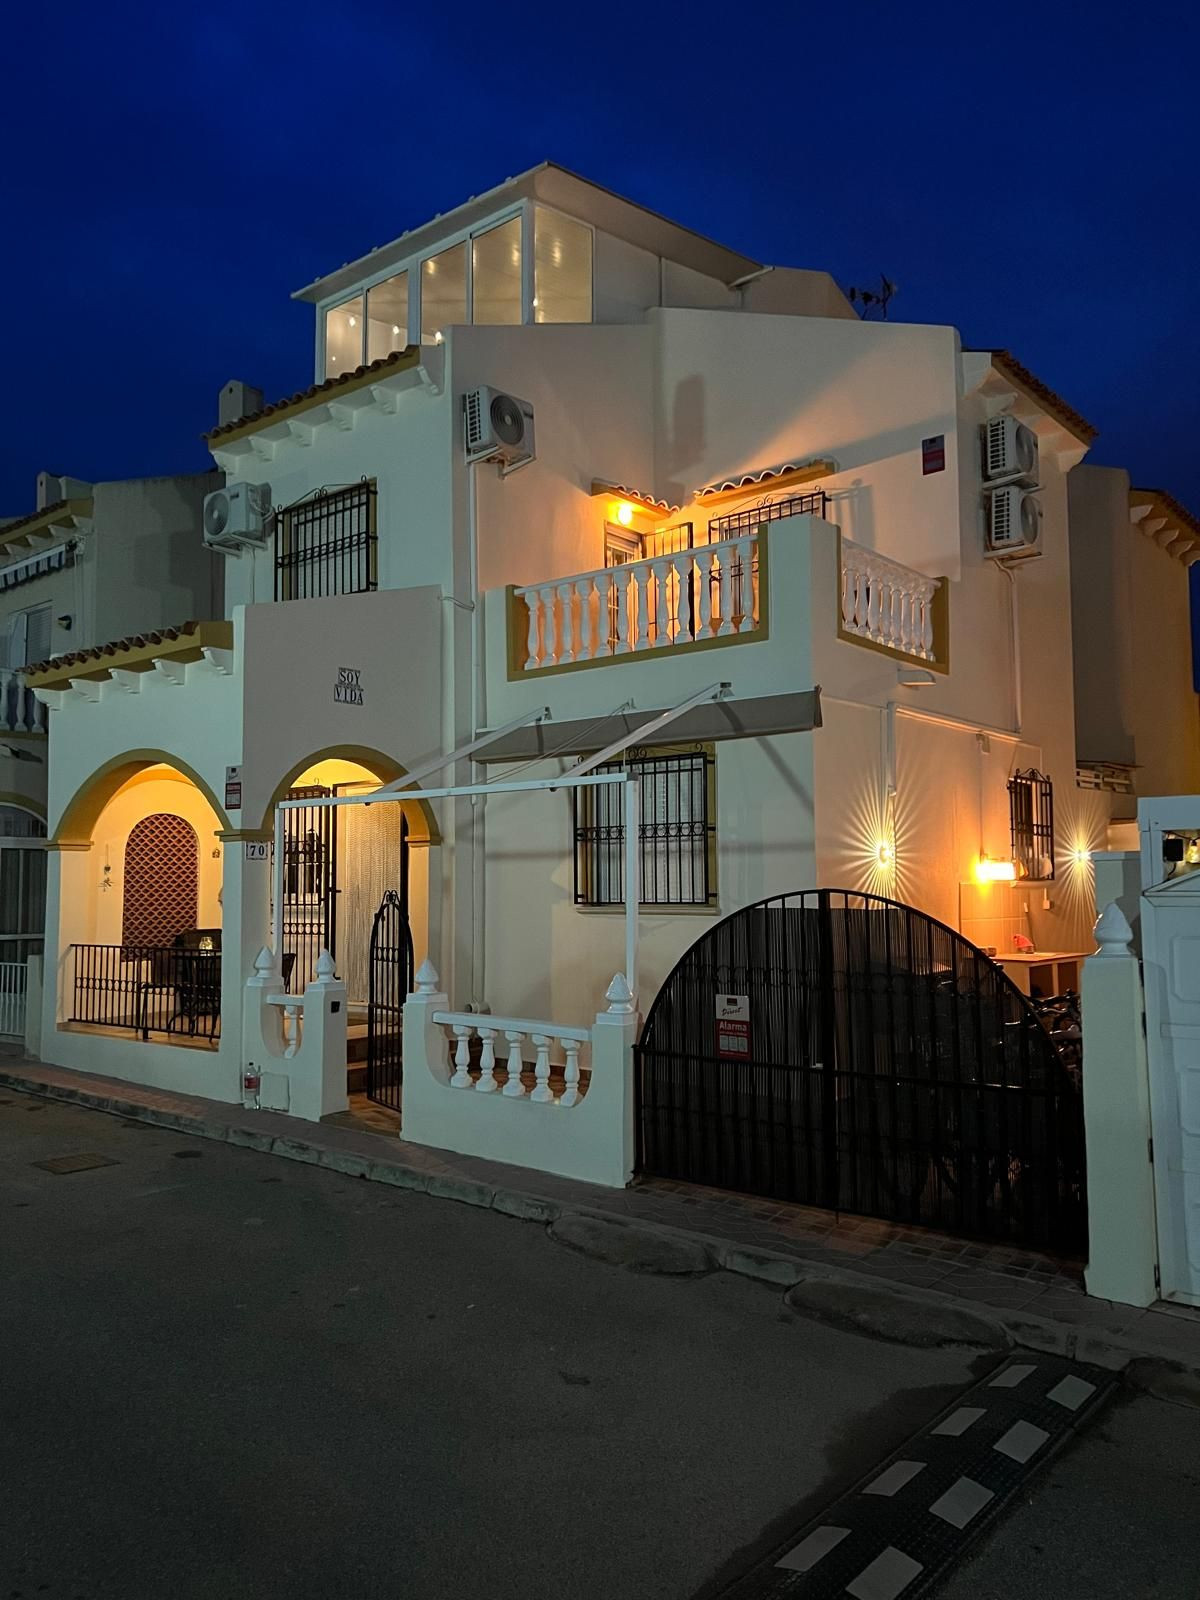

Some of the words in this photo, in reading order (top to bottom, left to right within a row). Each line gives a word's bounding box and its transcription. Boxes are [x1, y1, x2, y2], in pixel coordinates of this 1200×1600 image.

[339, 670, 360, 685] SOY
[336, 687, 363, 704] VIDA
[249, 845, 265, 856] 70
[719, 1021, 747, 1031] Alarma
